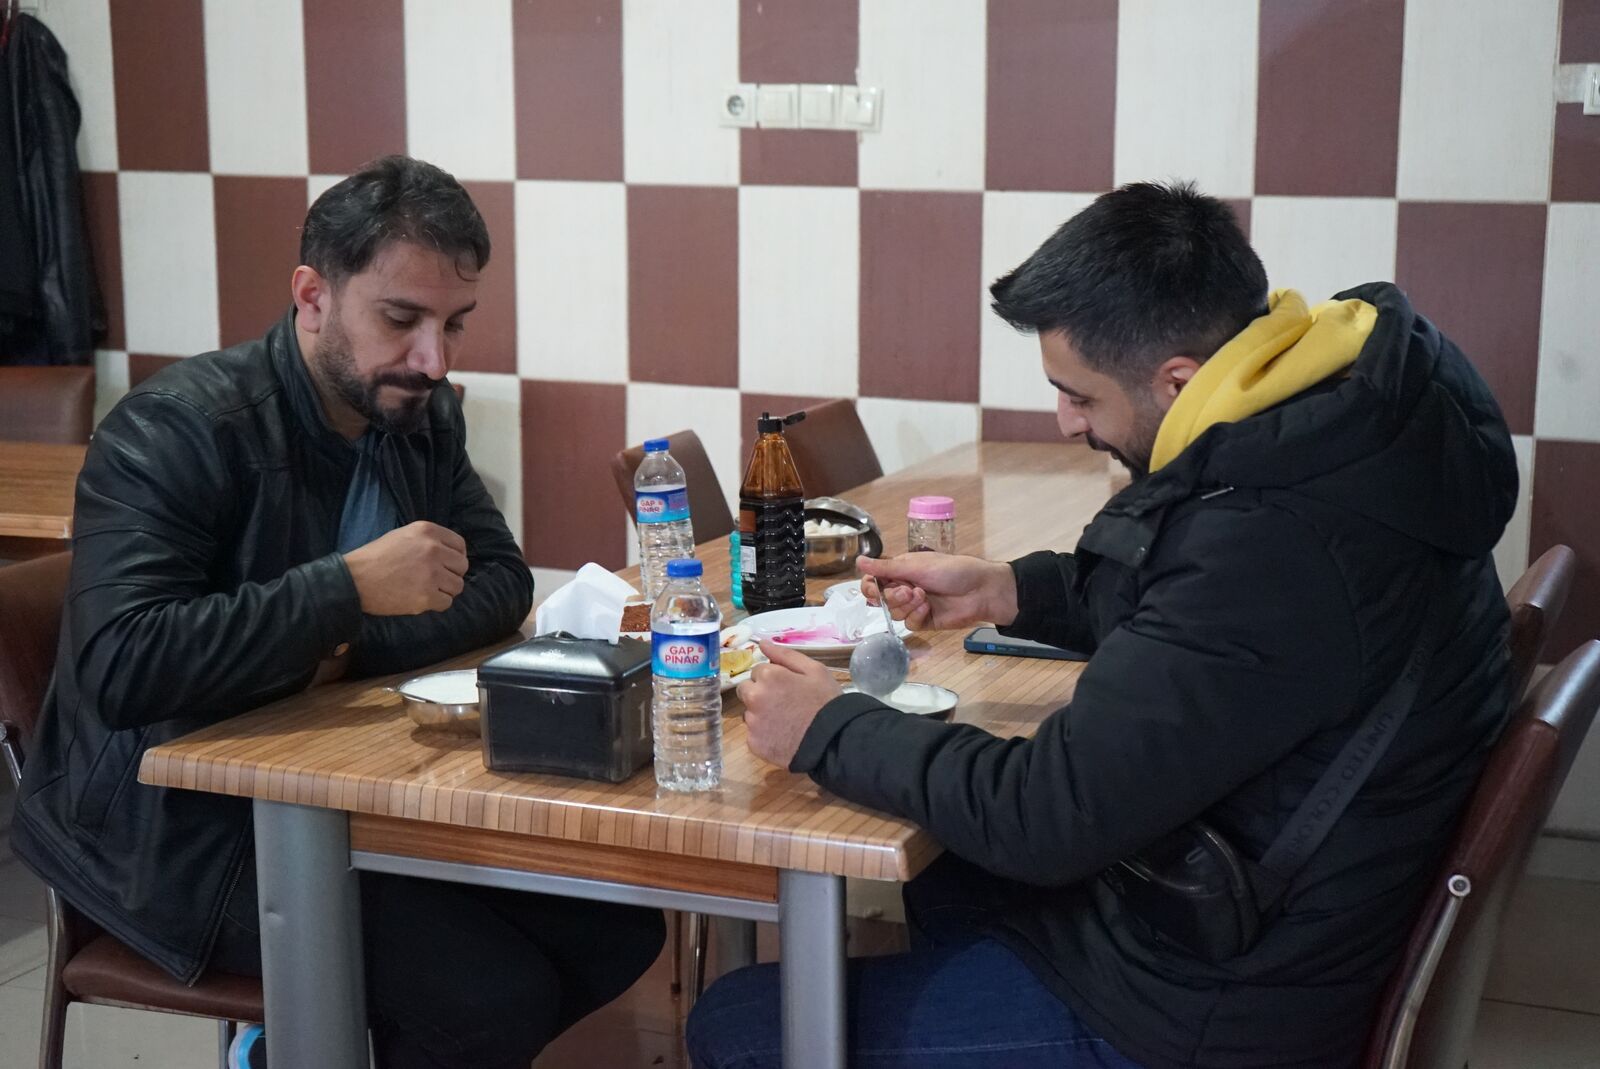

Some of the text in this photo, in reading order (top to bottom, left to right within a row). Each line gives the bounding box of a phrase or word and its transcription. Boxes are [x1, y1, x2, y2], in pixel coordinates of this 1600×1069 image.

[669, 646, 694, 655] GAP
[665, 655, 699, 664] PINAR
[1341, 711, 1395, 781] UNITED
